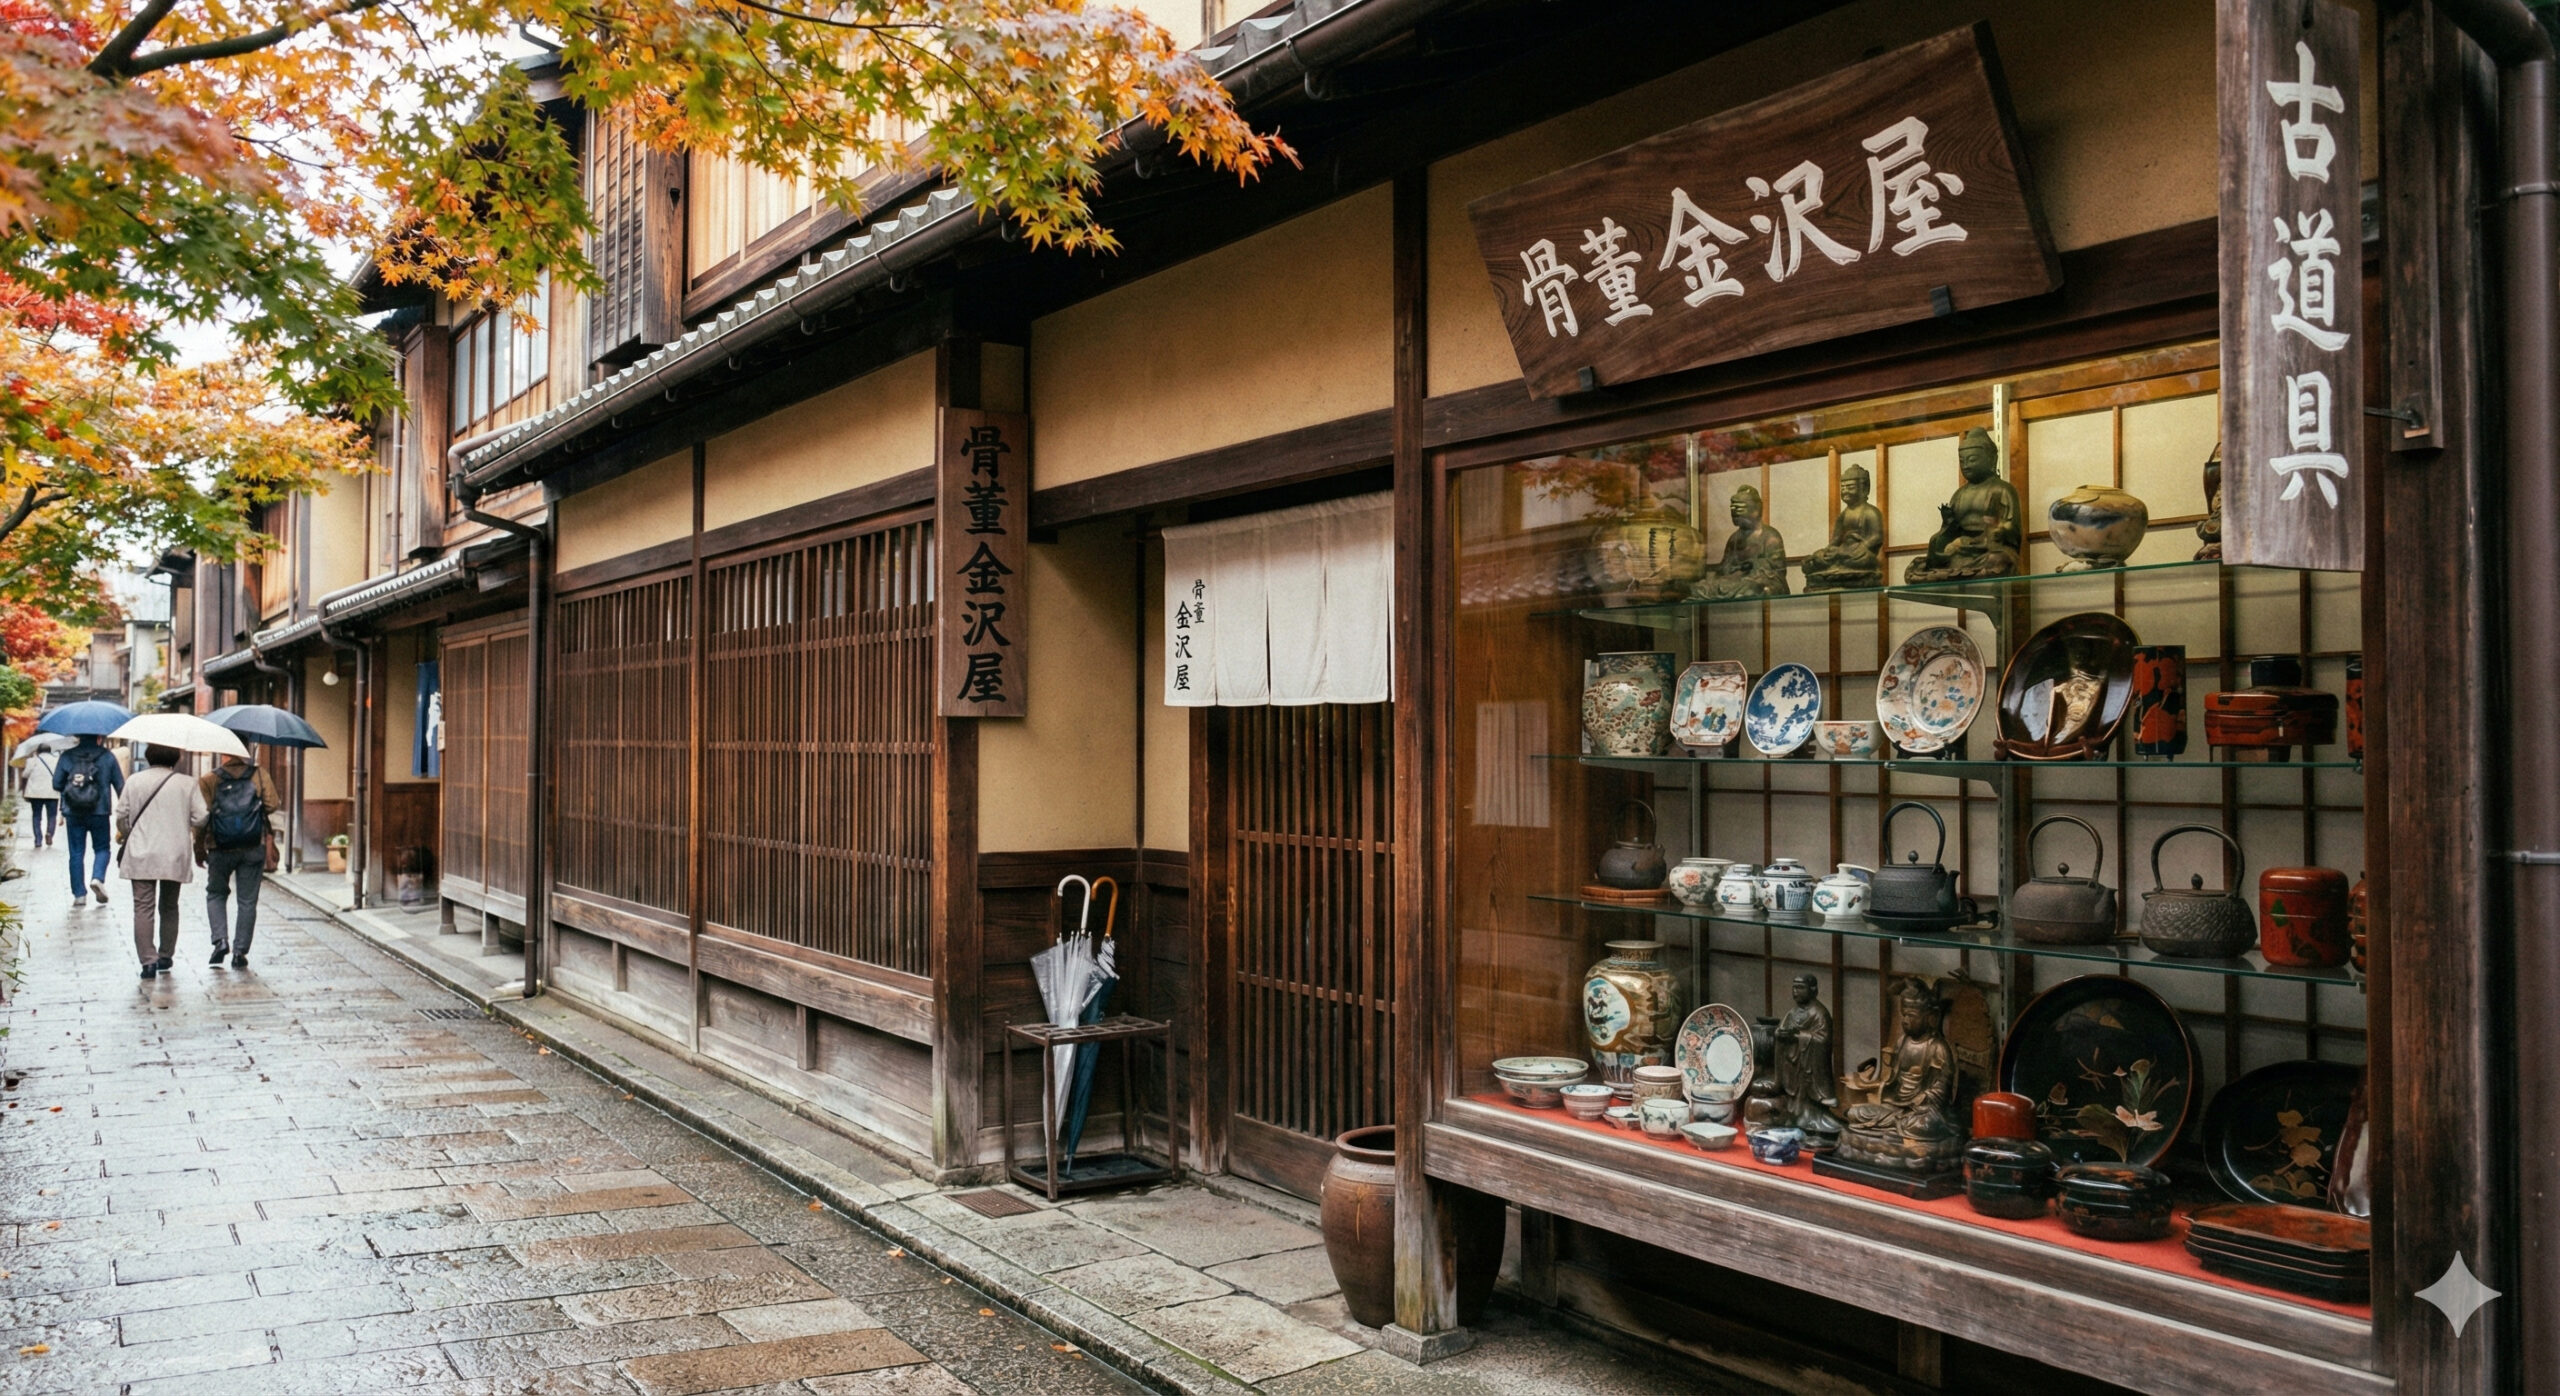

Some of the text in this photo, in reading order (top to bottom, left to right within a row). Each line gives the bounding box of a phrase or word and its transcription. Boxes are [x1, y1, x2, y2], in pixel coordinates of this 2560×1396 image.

[1521, 115, 1968, 338] 骨董金沢屋
[2266, 40, 2351, 509] 古道具
[956, 426, 1015, 704] 骨董金沢屋
[1174, 600, 1193, 691] 金沢屋
